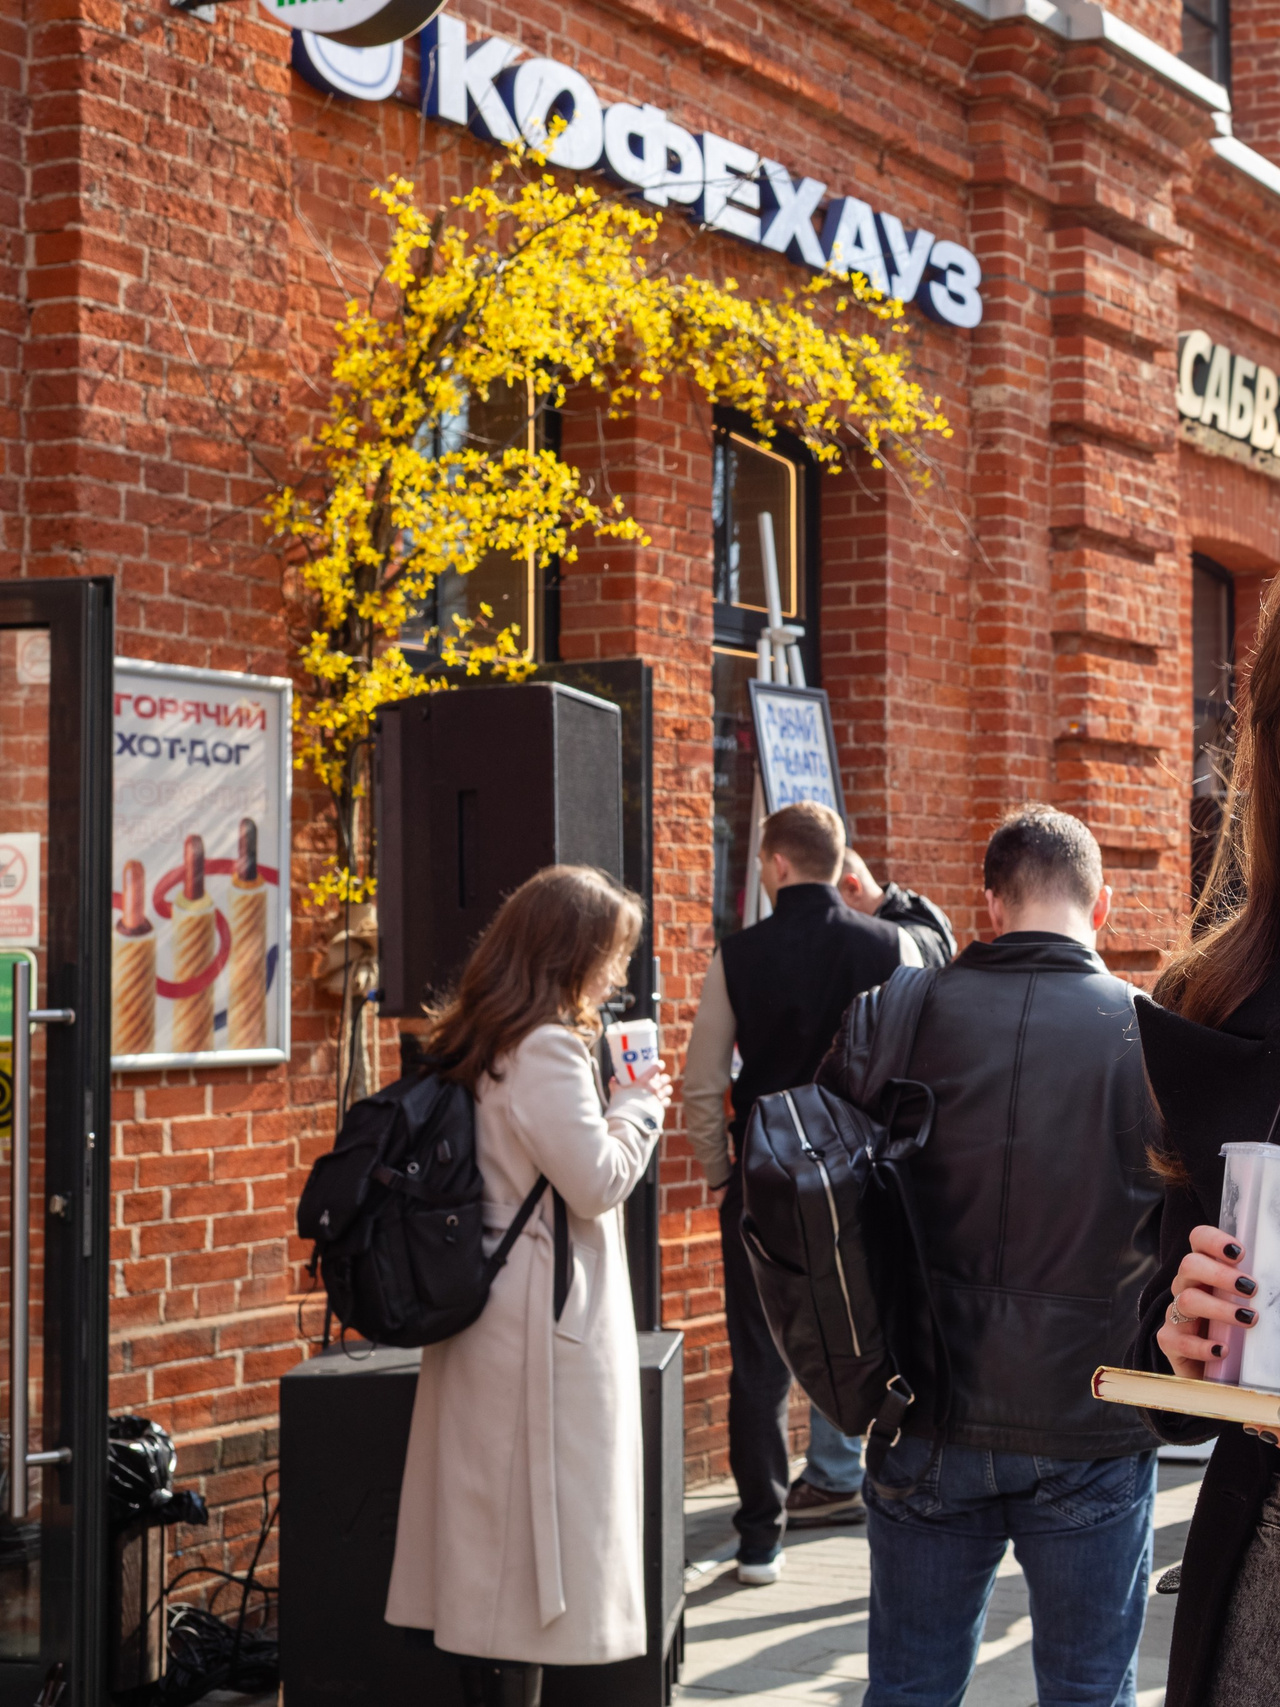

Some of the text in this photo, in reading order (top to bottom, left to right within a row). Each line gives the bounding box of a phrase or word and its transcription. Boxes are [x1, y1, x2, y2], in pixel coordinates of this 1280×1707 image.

[436, 13, 983, 328] КОФЕХАУЗ
[114, 692, 267, 731] ГОРЯЧИЙ
[115, 732, 250, 767] ХОТ-ДОГ
